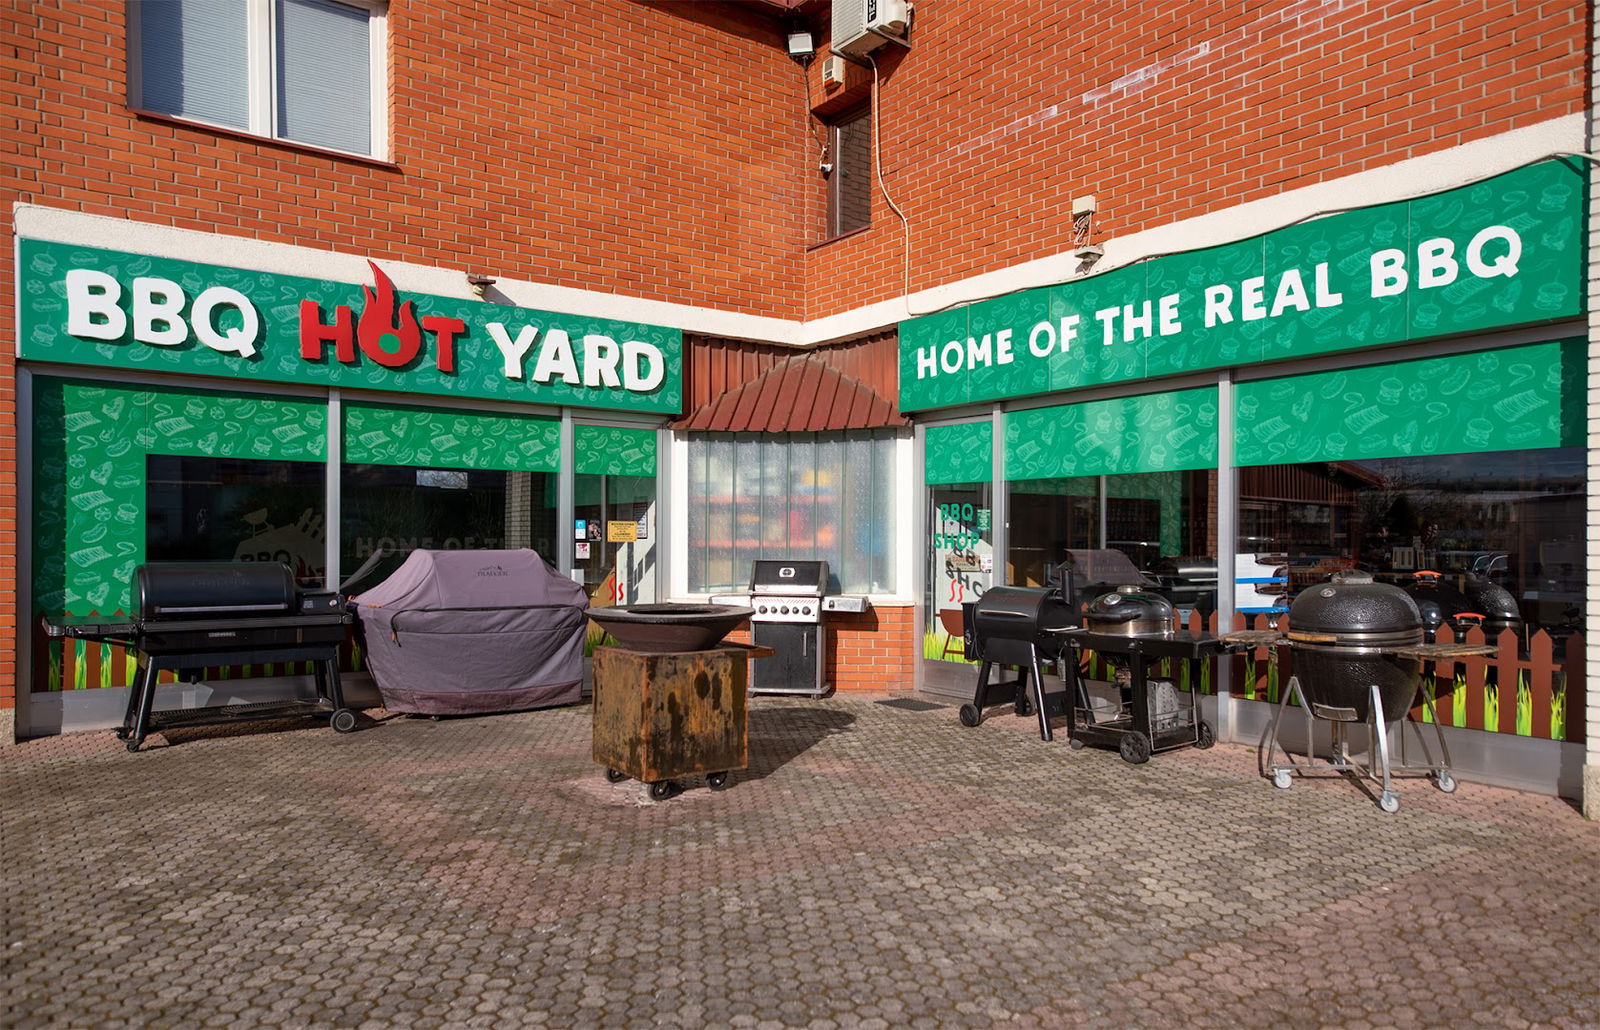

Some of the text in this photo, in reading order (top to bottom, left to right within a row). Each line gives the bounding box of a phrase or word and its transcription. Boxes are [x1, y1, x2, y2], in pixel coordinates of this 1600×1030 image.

[65, 259, 665, 392] BBQ HOT YARD
[917, 225, 1523, 380] HOME OF THE REAL BBQ
[934, 532, 979, 549] SHOP
[940, 503, 973, 521] BBQ
